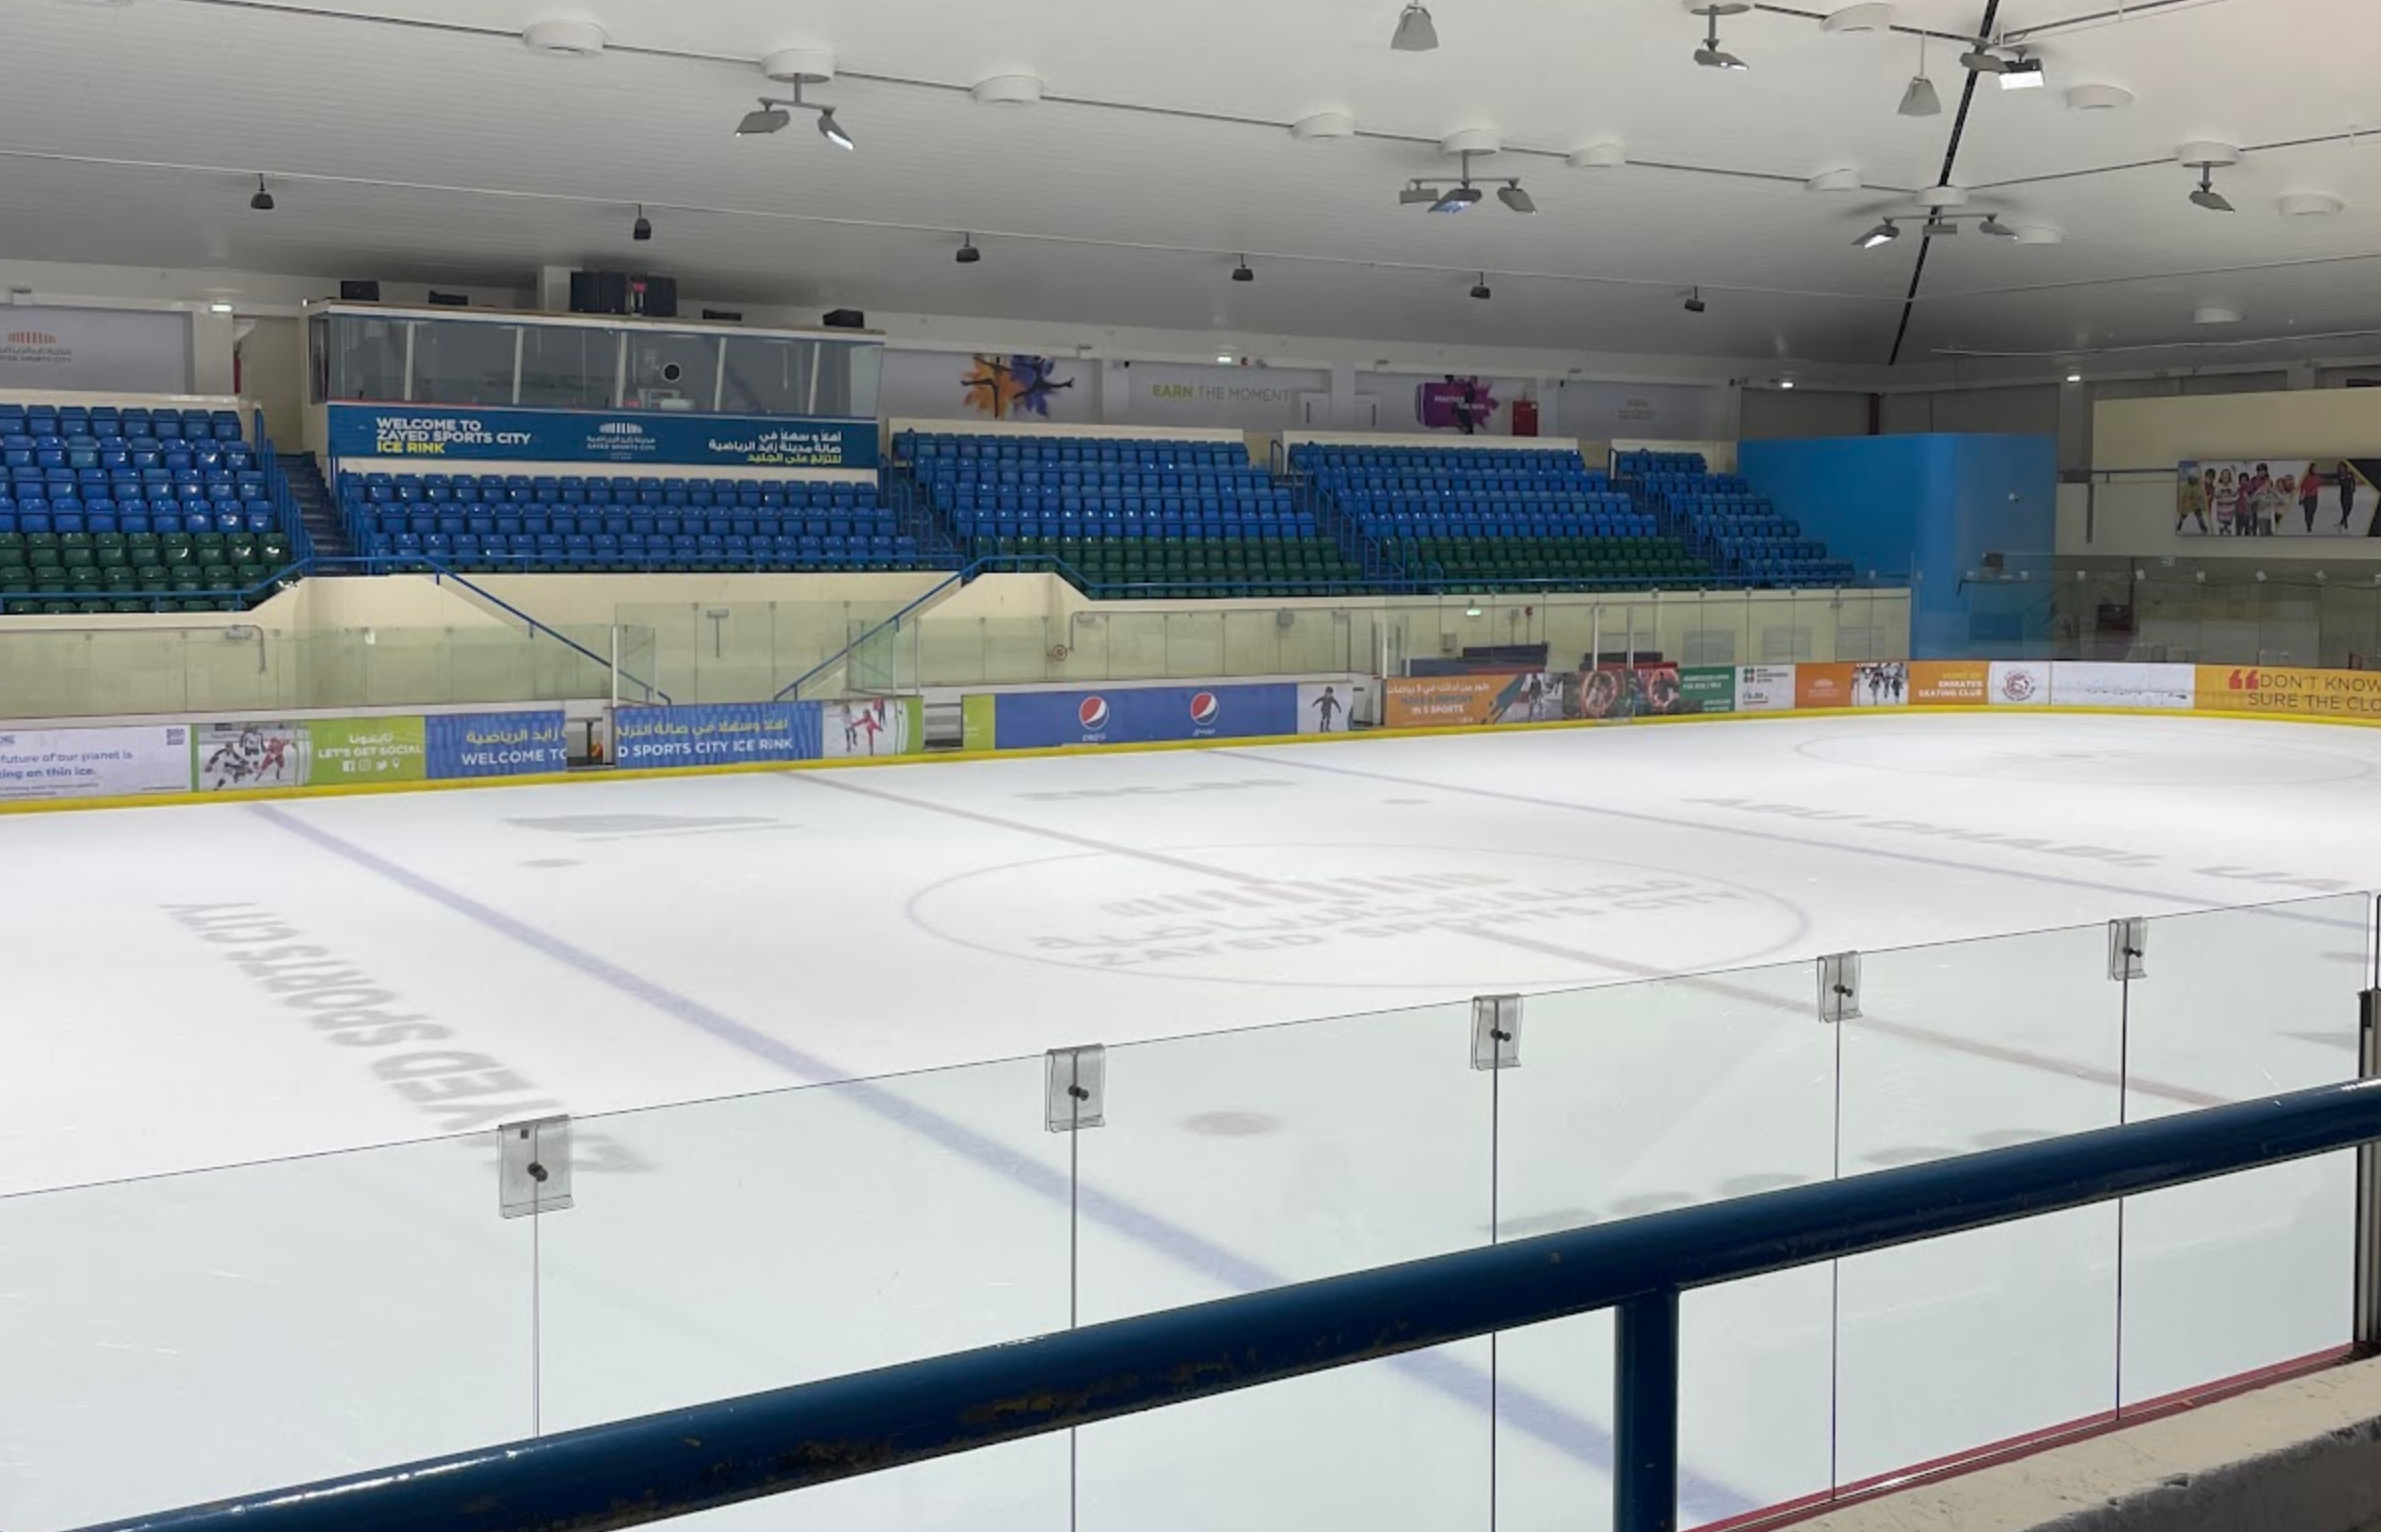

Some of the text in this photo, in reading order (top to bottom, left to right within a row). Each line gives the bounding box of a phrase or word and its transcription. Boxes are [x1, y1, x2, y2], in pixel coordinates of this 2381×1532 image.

[1152, 384, 1289, 402] EARN THE MOMENT
[376, 417, 482, 432] WELCOME TO
[376, 430, 531, 445] ZAYED SPORTS CITY
[708, 438, 756, 452] الرياضية
[377, 441, 446, 454] ICE RINK
[1938, 680, 1983, 689] EMIRATES
[2260, 673, 2319, 690] DON'T
[1918, 689, 1983, 699] SKATING CLUB
[2249, 693, 2298, 707] SURE
[2304, 695, 2341, 710] THE
[1430, 704, 1465, 714] SPORTS
[466, 728, 528, 745] الرياضية
[318, 744, 422, 758] LET'S GET SOCIAL
[633, 743, 692, 757] SPORTS
[695, 740, 729, 754] CITY
[733, 739, 755, 752] ICE
[760, 738, 794, 751] RINK
[1, 750, 133, 764] future of our planet is
[461, 750, 544, 766] WELCOME
[0, 768, 22, 779] ing
[47, 767, 72, 777] thin
[156, 901, 301, 944] CITY
[1080, 890, 1748, 966] ZAYED SPORTS CITY
[224, 944, 458, 1048] SPORTS
